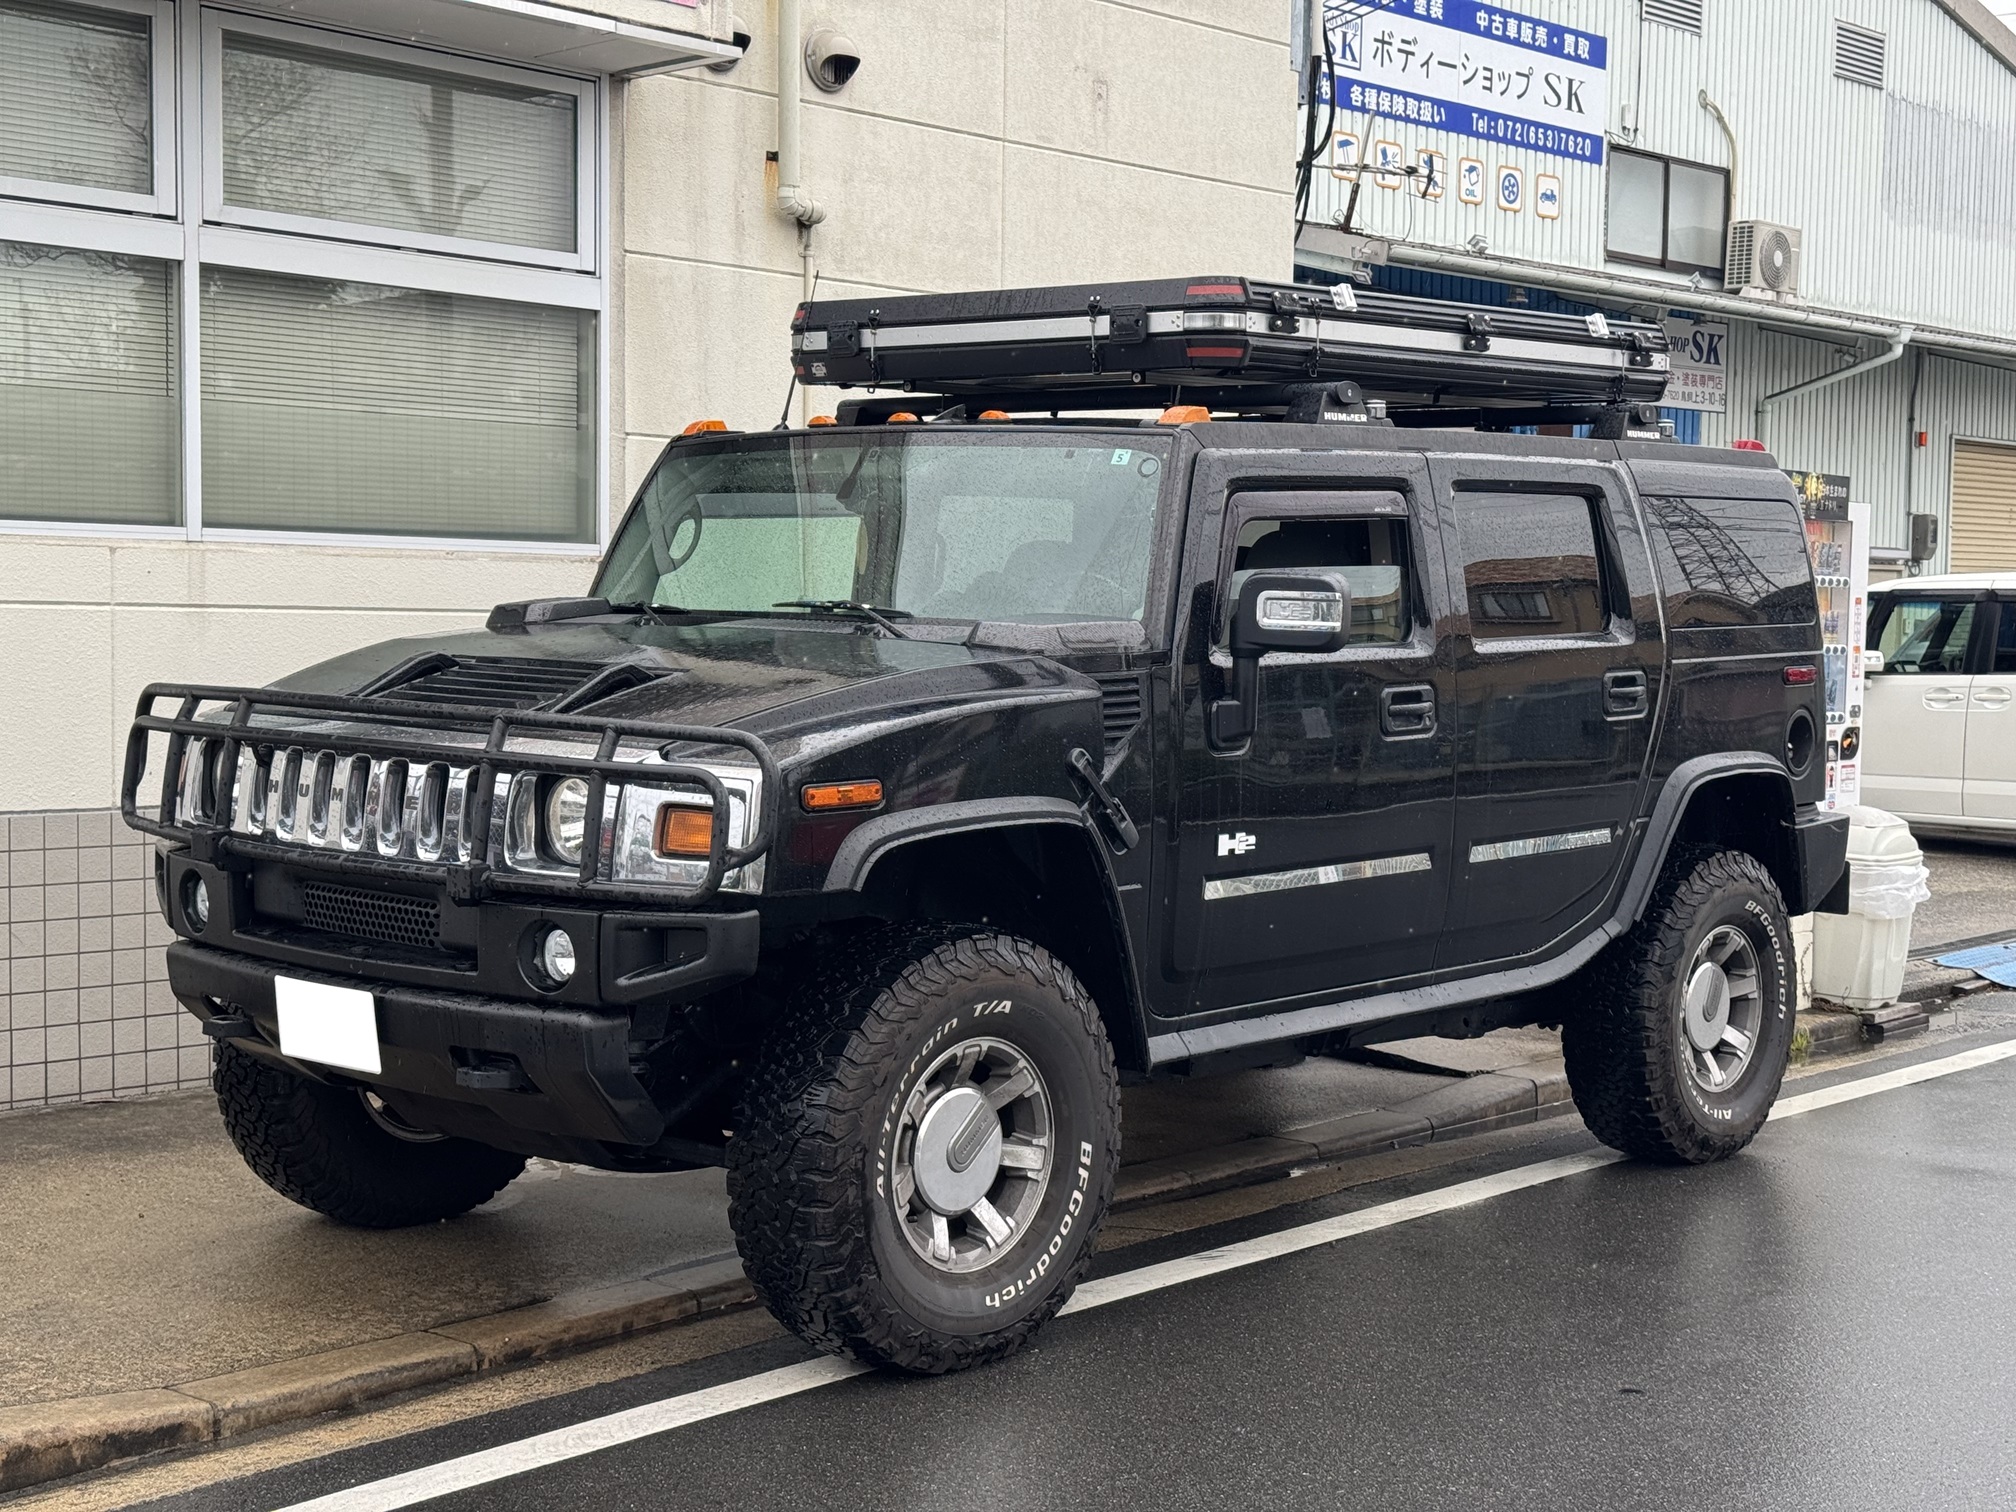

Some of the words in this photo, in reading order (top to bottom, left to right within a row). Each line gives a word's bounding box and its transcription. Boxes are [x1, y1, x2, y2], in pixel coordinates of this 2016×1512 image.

[1475, 9, 1590, 61] 中古車販売・買取
[1372, 30, 1534, 101] ボディーショップ
[1543, 72, 1586, 115] SK
[1349, 83, 1446, 124] 各種保険取扱い
[1471, 112, 1592, 158] Tel:072(653)7620
[1464, 187, 1478, 198] OIL
[1665, 334, 1690, 353] HOP
[1690, 330, 1725, 366] SK
[1323, 411, 1368, 422] HUMMER
[1217, 832, 1257, 857] H2
[1744, 900, 1787, 1020] BFGoodrich
[876, 1017, 958, 1199] All-Terrain
[973, 999, 1013, 1018] T/A
[985, 1140, 1093, 1309] BFGoodrich
